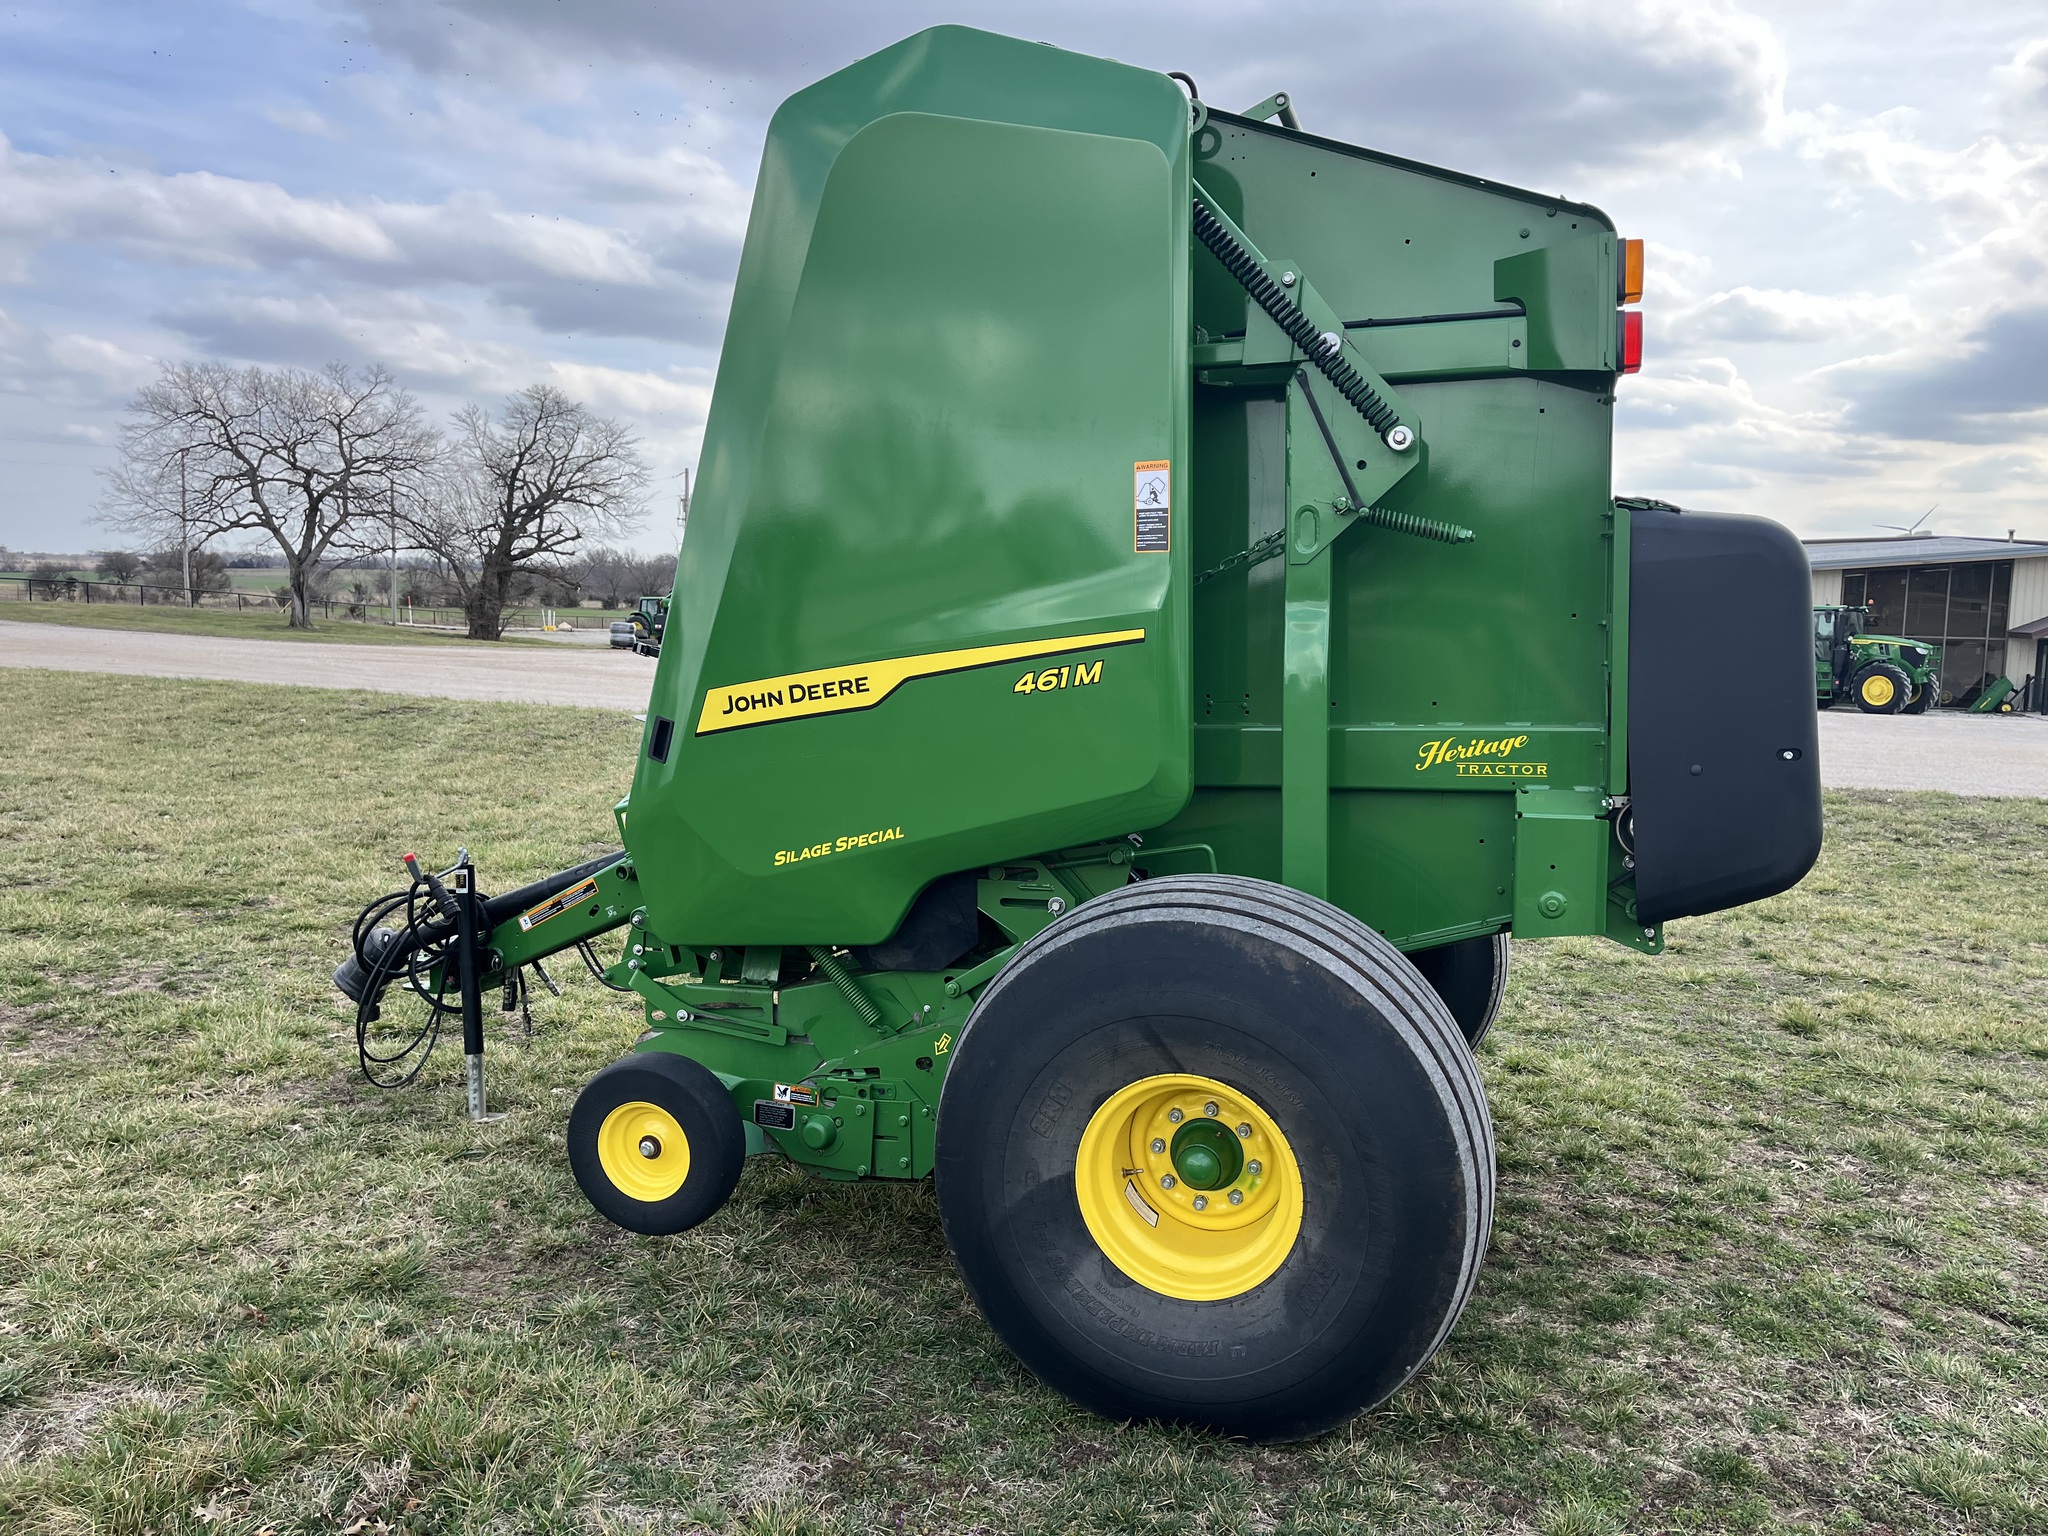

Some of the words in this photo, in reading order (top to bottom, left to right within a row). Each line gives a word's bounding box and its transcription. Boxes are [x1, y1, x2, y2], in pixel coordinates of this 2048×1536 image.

[722, 683, 784, 715] JOHN
[789, 676, 870, 705] DEERE
[1012, 665, 1071, 695] 461
[1073, 660, 1105, 687] M
[1415, 734, 1530, 771] Heritage
[1456, 764, 1548, 775] TRACTOR
[774, 840, 833, 866] SILAGE
[835, 826, 905, 853] SPECIAL
[1046, 1255, 1156, 1346] IMPLEMENT
[1093, 1281, 1141, 1318] FLOTATION
